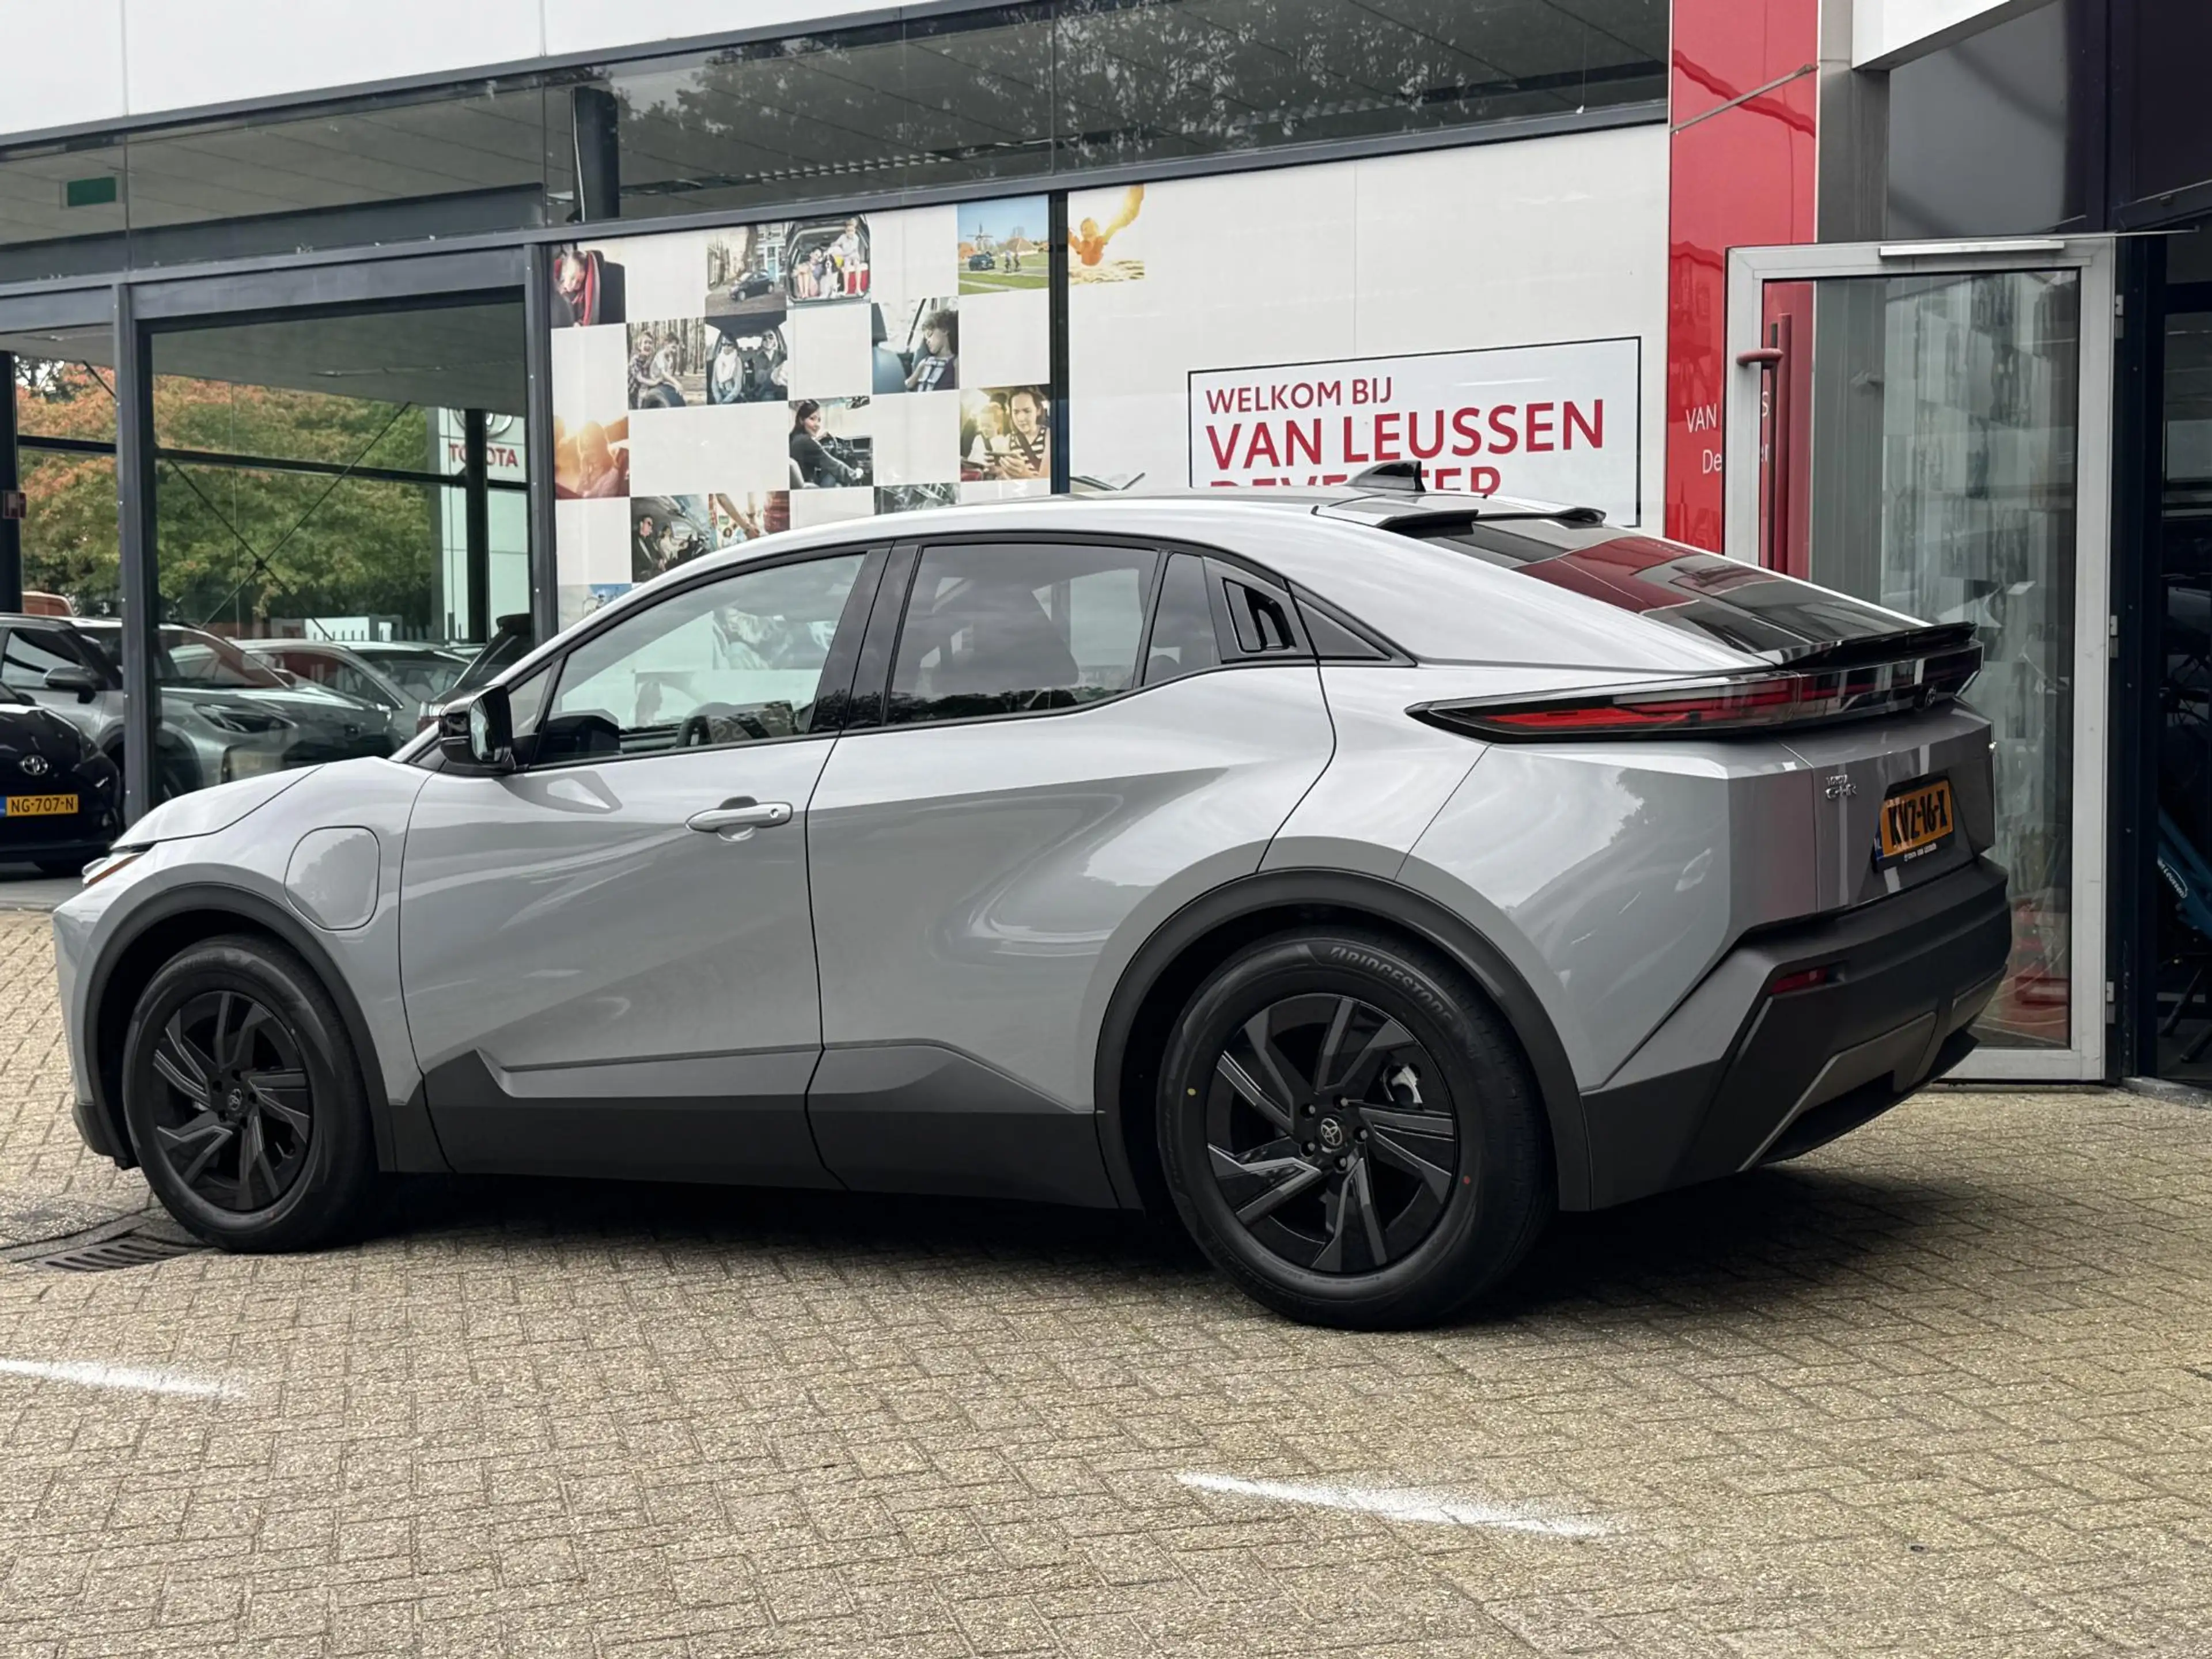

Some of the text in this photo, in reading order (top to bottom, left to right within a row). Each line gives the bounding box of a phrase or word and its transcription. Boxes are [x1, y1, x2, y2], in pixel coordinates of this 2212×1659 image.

[1206, 377, 1392, 414] WELKOM BIJ
[1685, 403, 1717, 433] VAN
[1206, 400, 1603, 470] VAN LEUSSEN
[11, 797, 74, 813] NG-707-N
